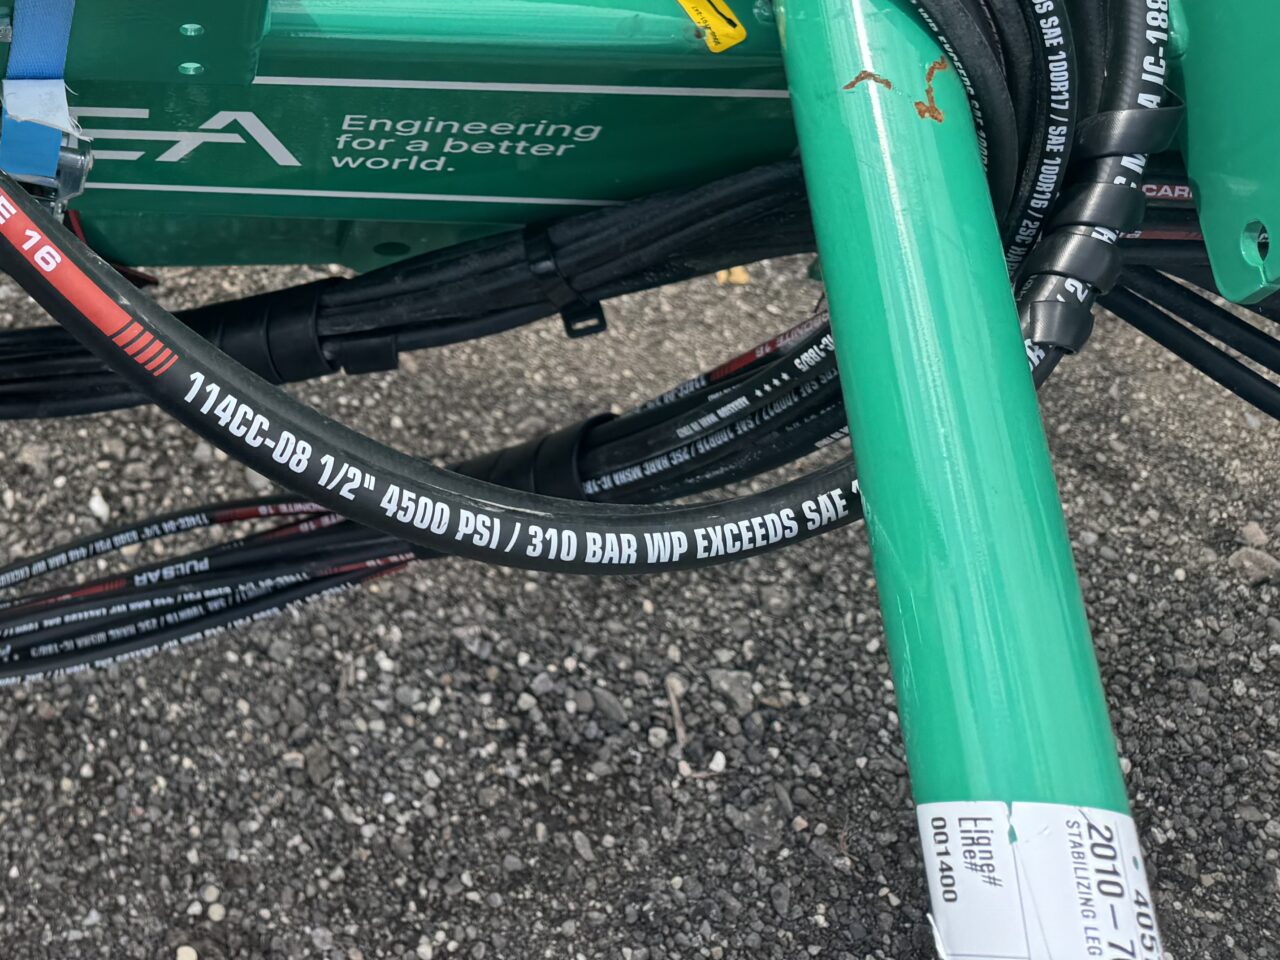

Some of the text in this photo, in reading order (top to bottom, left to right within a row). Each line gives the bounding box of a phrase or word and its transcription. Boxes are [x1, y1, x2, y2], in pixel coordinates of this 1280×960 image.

[1038, 16, 1065, 50] SAE
[1047, 49, 1071, 113] 100R17
[334, 133, 576, 158] for a better
[341, 114, 603, 141] Engineering
[1045, 124, 1068, 154] SAE
[330, 152, 457, 173] world.
[1029, 157, 1061, 210] 100R16
[1141, 183, 1193, 199] CAR
[20, 227, 63, 273] 16
[182, 371, 314, 476] 114CC-08
[318, 452, 378, 502] 1/2"
[379, 482, 451, 538] 4500
[456, 509, 503, 551] PSI
[526, 524, 578, 563] 310
[585, 529, 638, 566] BAR
[644, 528, 691, 566] WP
[695, 507, 800, 562] EXCEEDS
[801, 487, 850, 530] SAE
[929, 815, 958, 904] 001400
[1064, 818, 1104, 958] STABILIZING LEG
